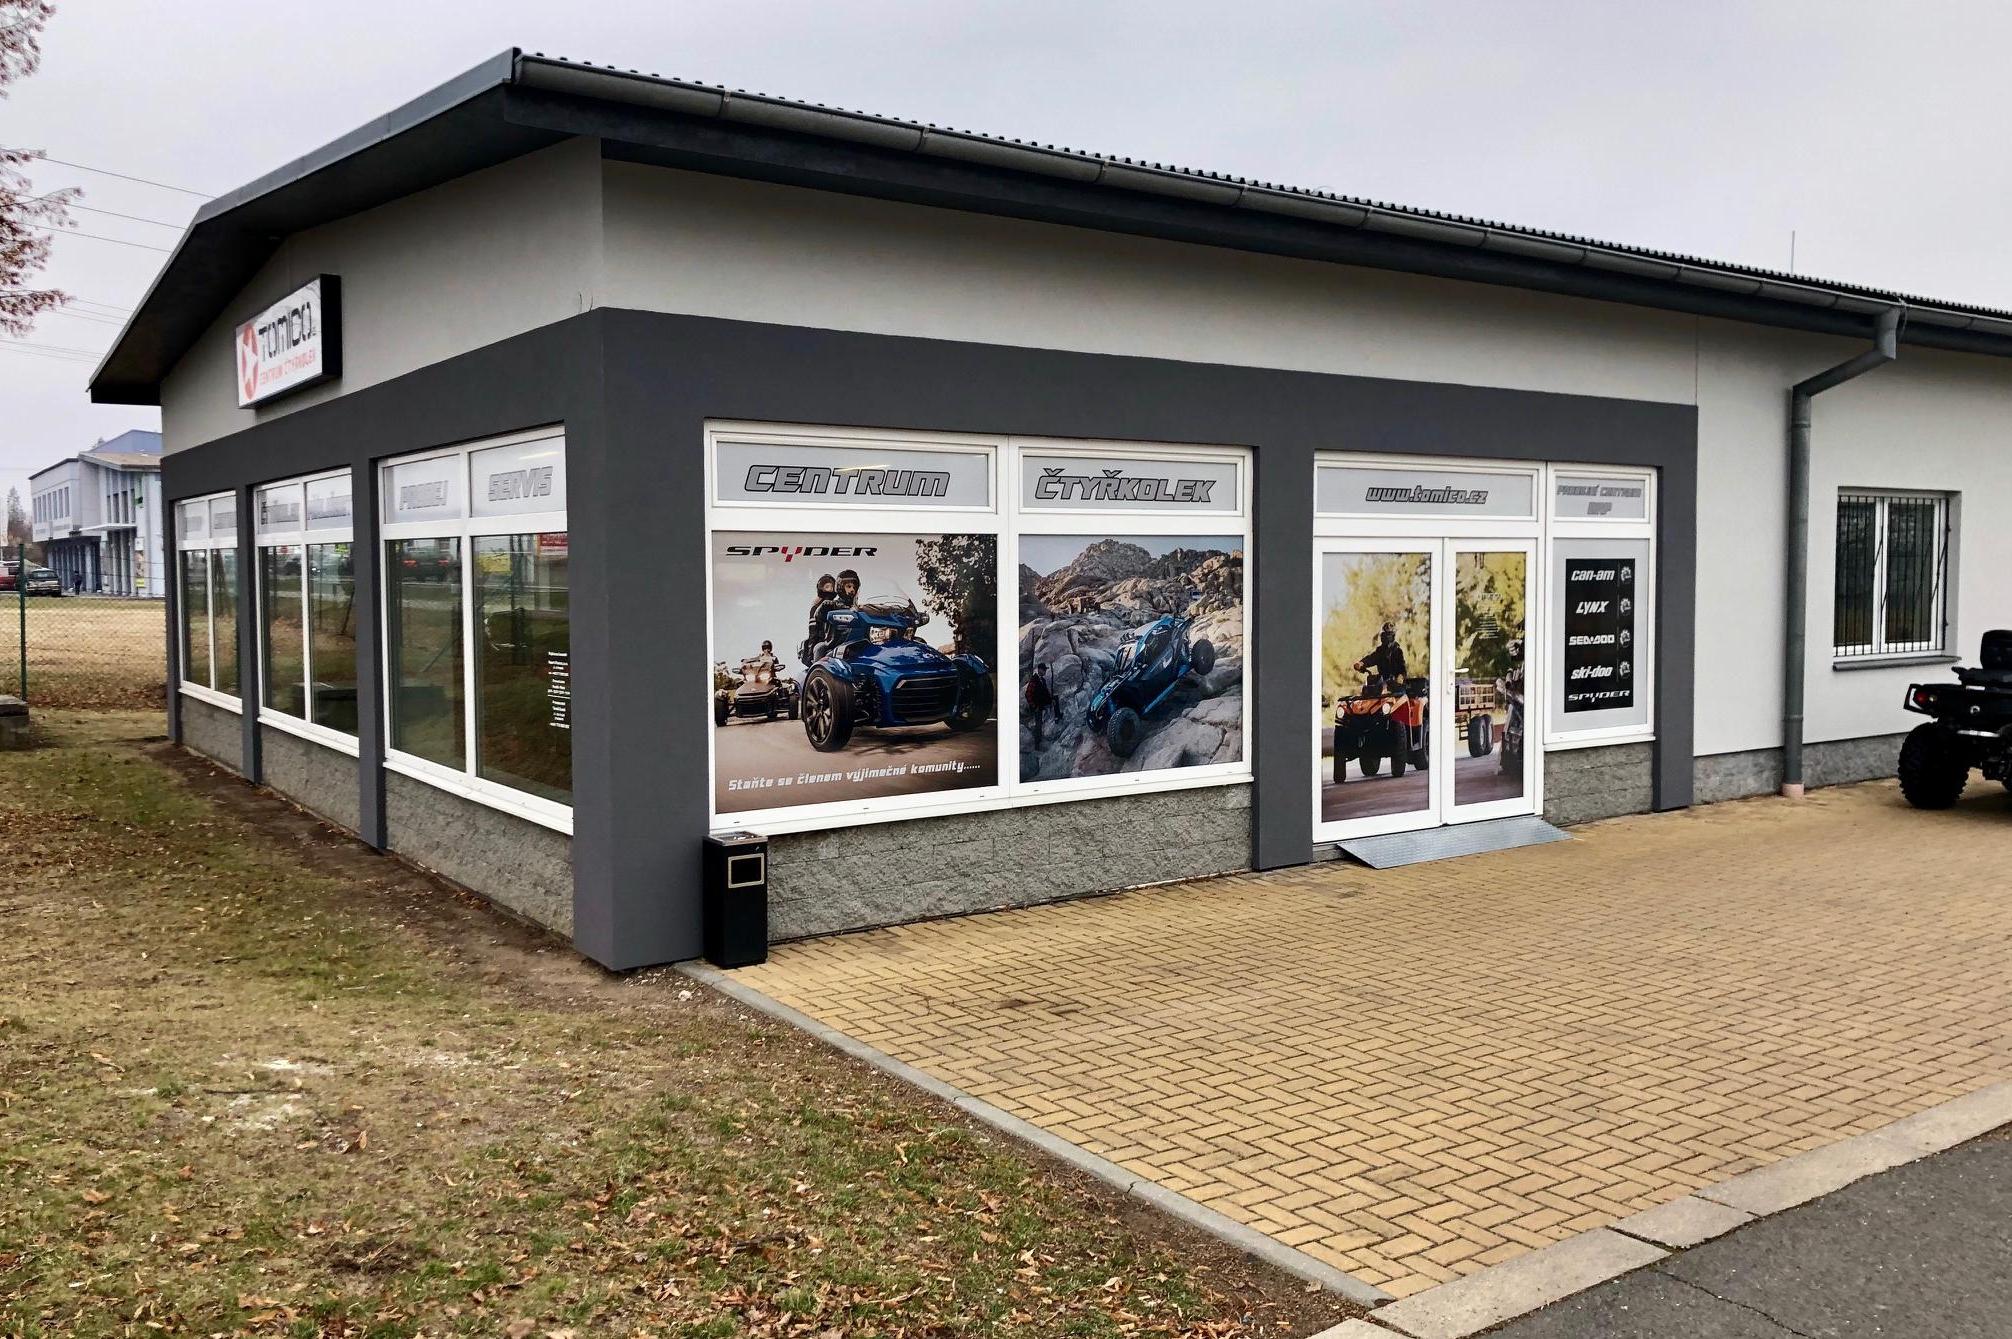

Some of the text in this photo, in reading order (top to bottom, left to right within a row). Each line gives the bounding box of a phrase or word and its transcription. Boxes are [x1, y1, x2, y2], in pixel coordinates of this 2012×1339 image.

[488, 465, 553, 502] SERVIS
[744, 464, 1217, 502] CENTRUM ČTYŘKOLEK
[726, 546, 878, 563] SPYDER
[1568, 690, 1631, 703] SPYDER
[728, 777, 774, 791] Staňte
